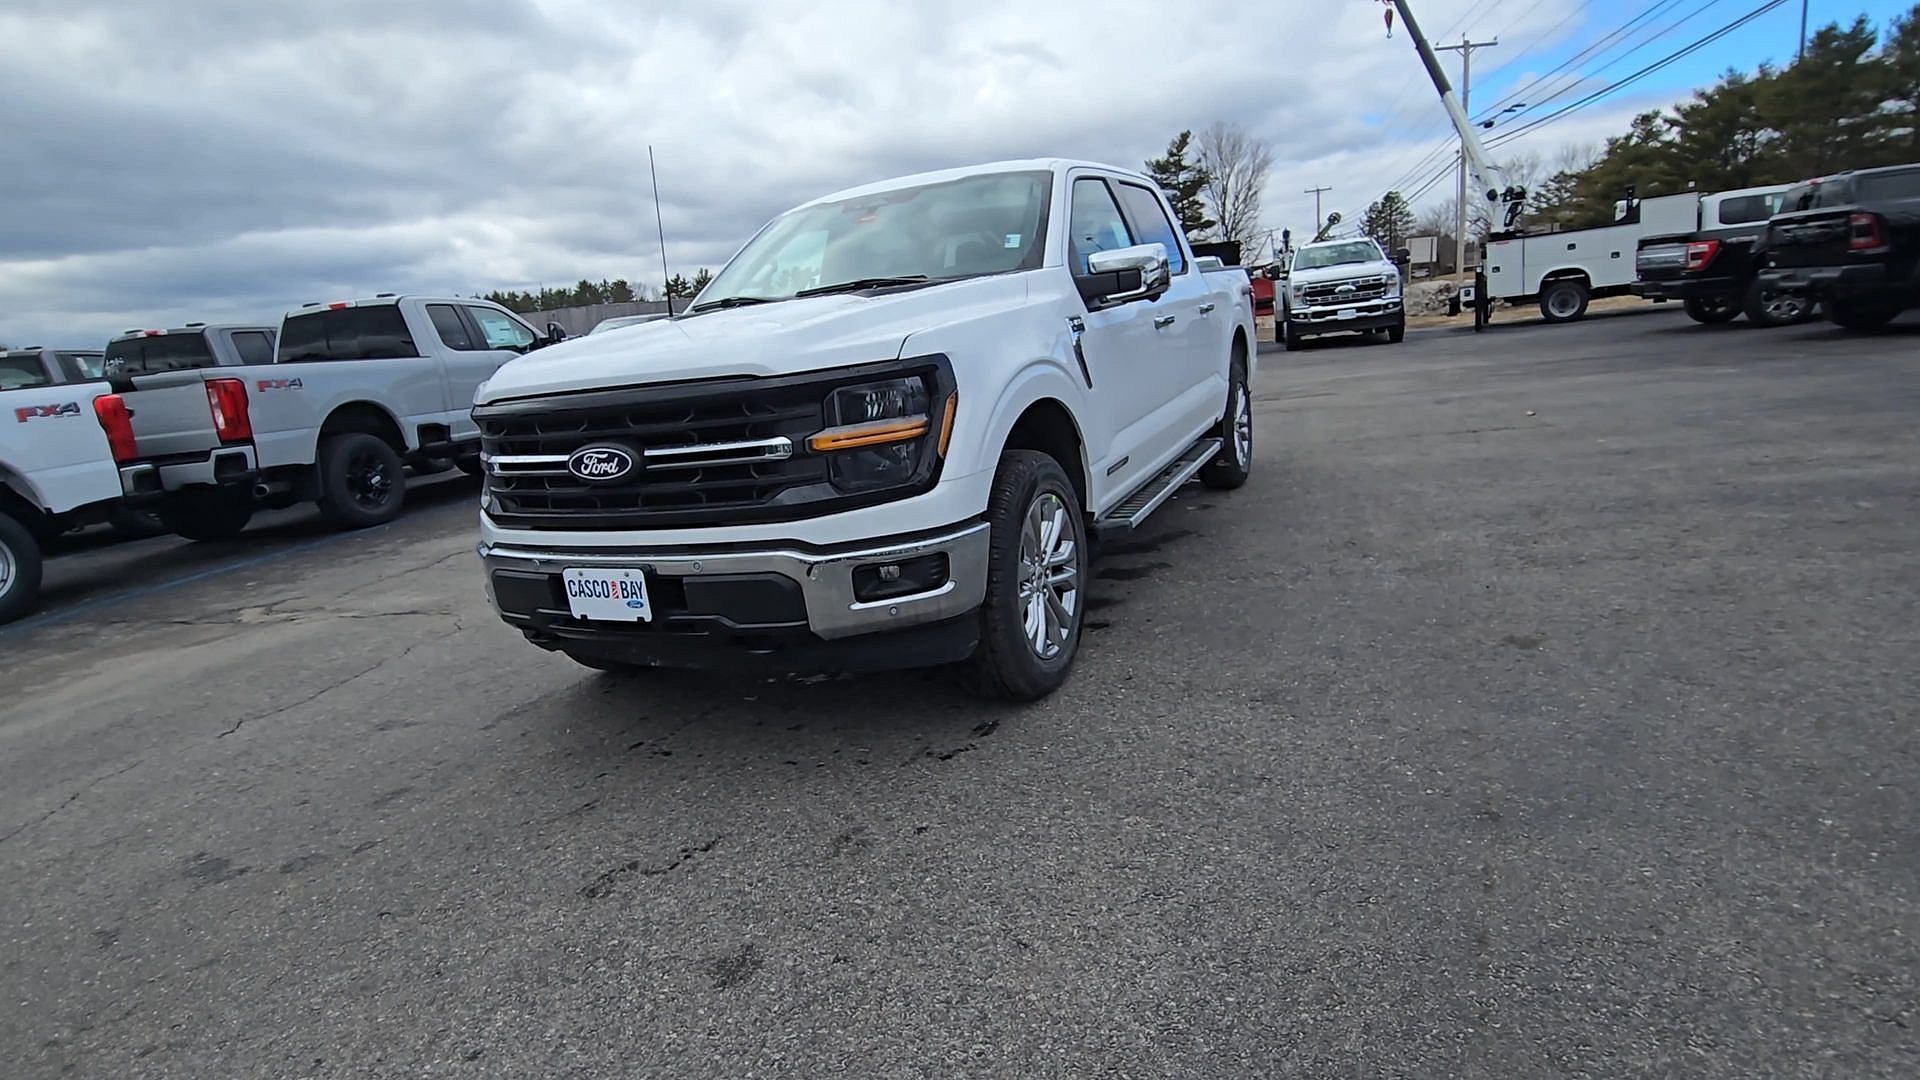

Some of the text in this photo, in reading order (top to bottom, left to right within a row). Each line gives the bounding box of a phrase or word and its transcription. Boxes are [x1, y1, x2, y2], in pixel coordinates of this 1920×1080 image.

[15, 402, 81, 423] FX4
[581, 453, 619, 474] Ford
[568, 580, 643, 600] CASCO BAY
